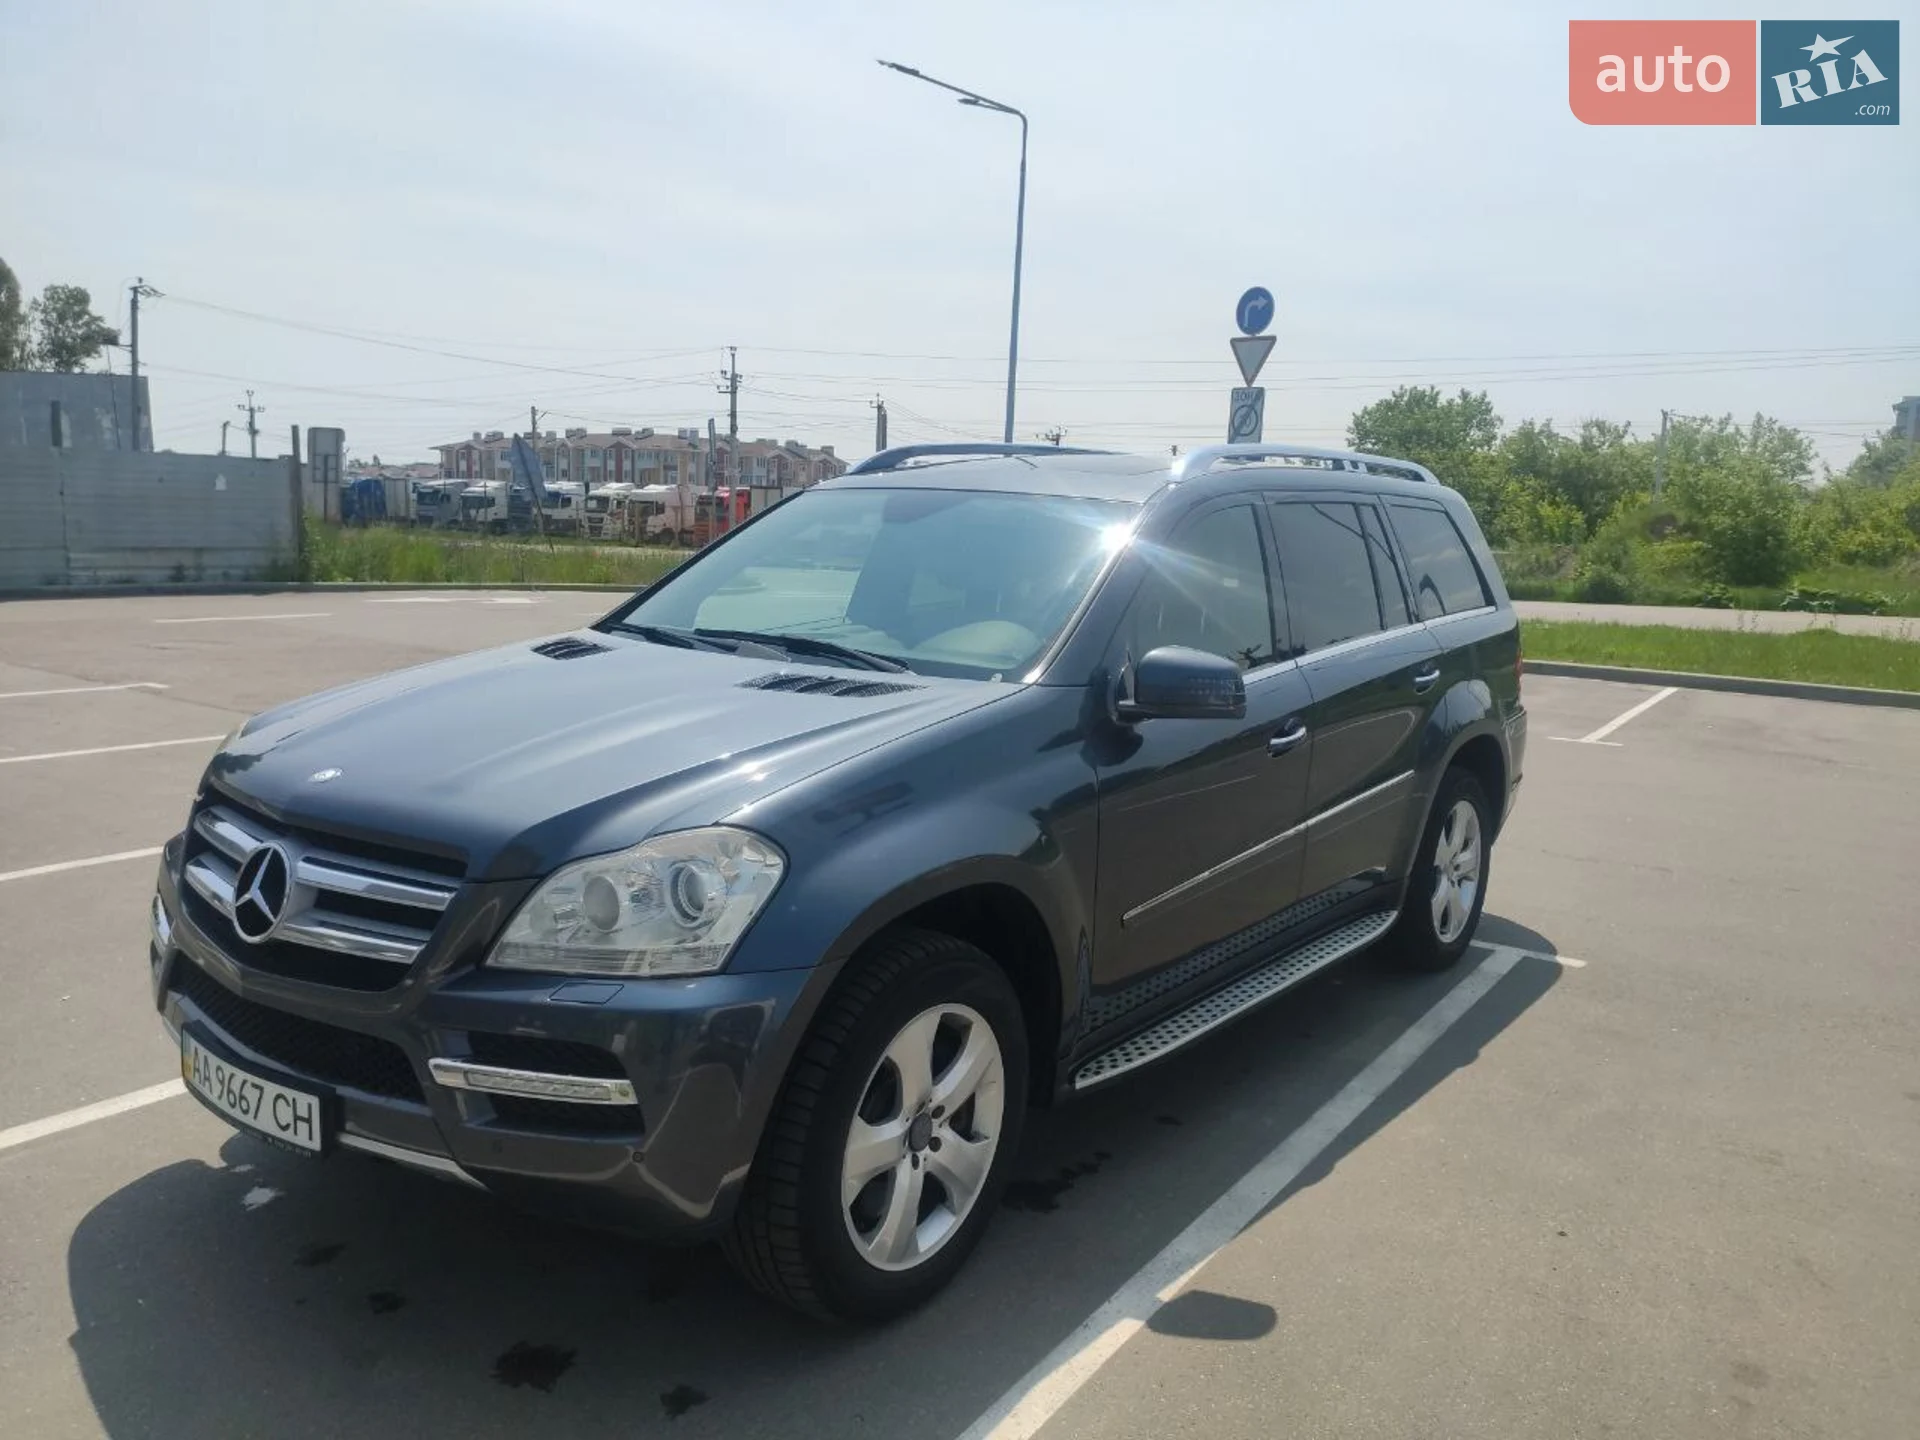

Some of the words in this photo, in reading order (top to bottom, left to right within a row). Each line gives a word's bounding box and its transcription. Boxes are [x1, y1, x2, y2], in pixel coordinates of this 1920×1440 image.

[193, 1046, 213, 1094] AA
[215, 1064, 265, 1121] 9667
[272, 1092, 313, 1141] CH
